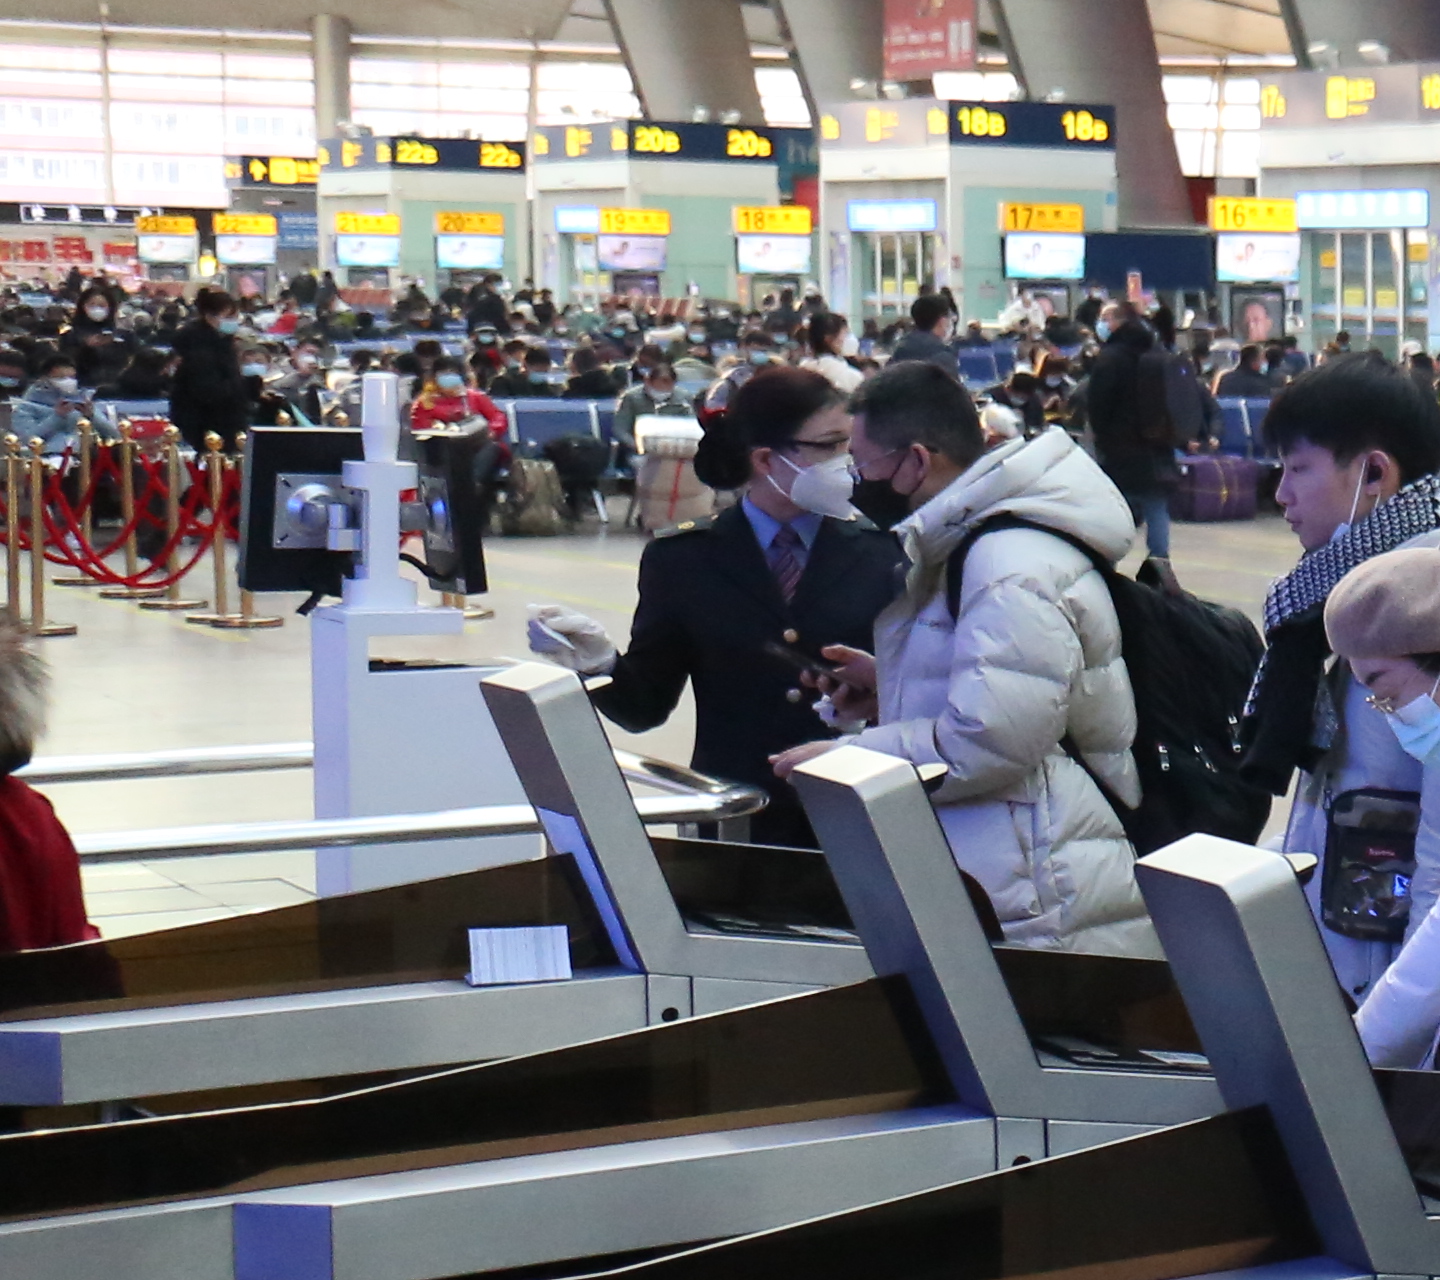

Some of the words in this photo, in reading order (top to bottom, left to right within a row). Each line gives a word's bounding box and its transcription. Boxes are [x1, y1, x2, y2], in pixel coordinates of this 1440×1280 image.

[958, 107, 1005, 137] 18B
[1062, 111, 1108, 141] 18B
[635, 126, 680, 153] 20B
[727, 129, 771, 157] 20B
[1009, 207, 1034, 230] 17
[1219, 204, 1246, 228] 16
